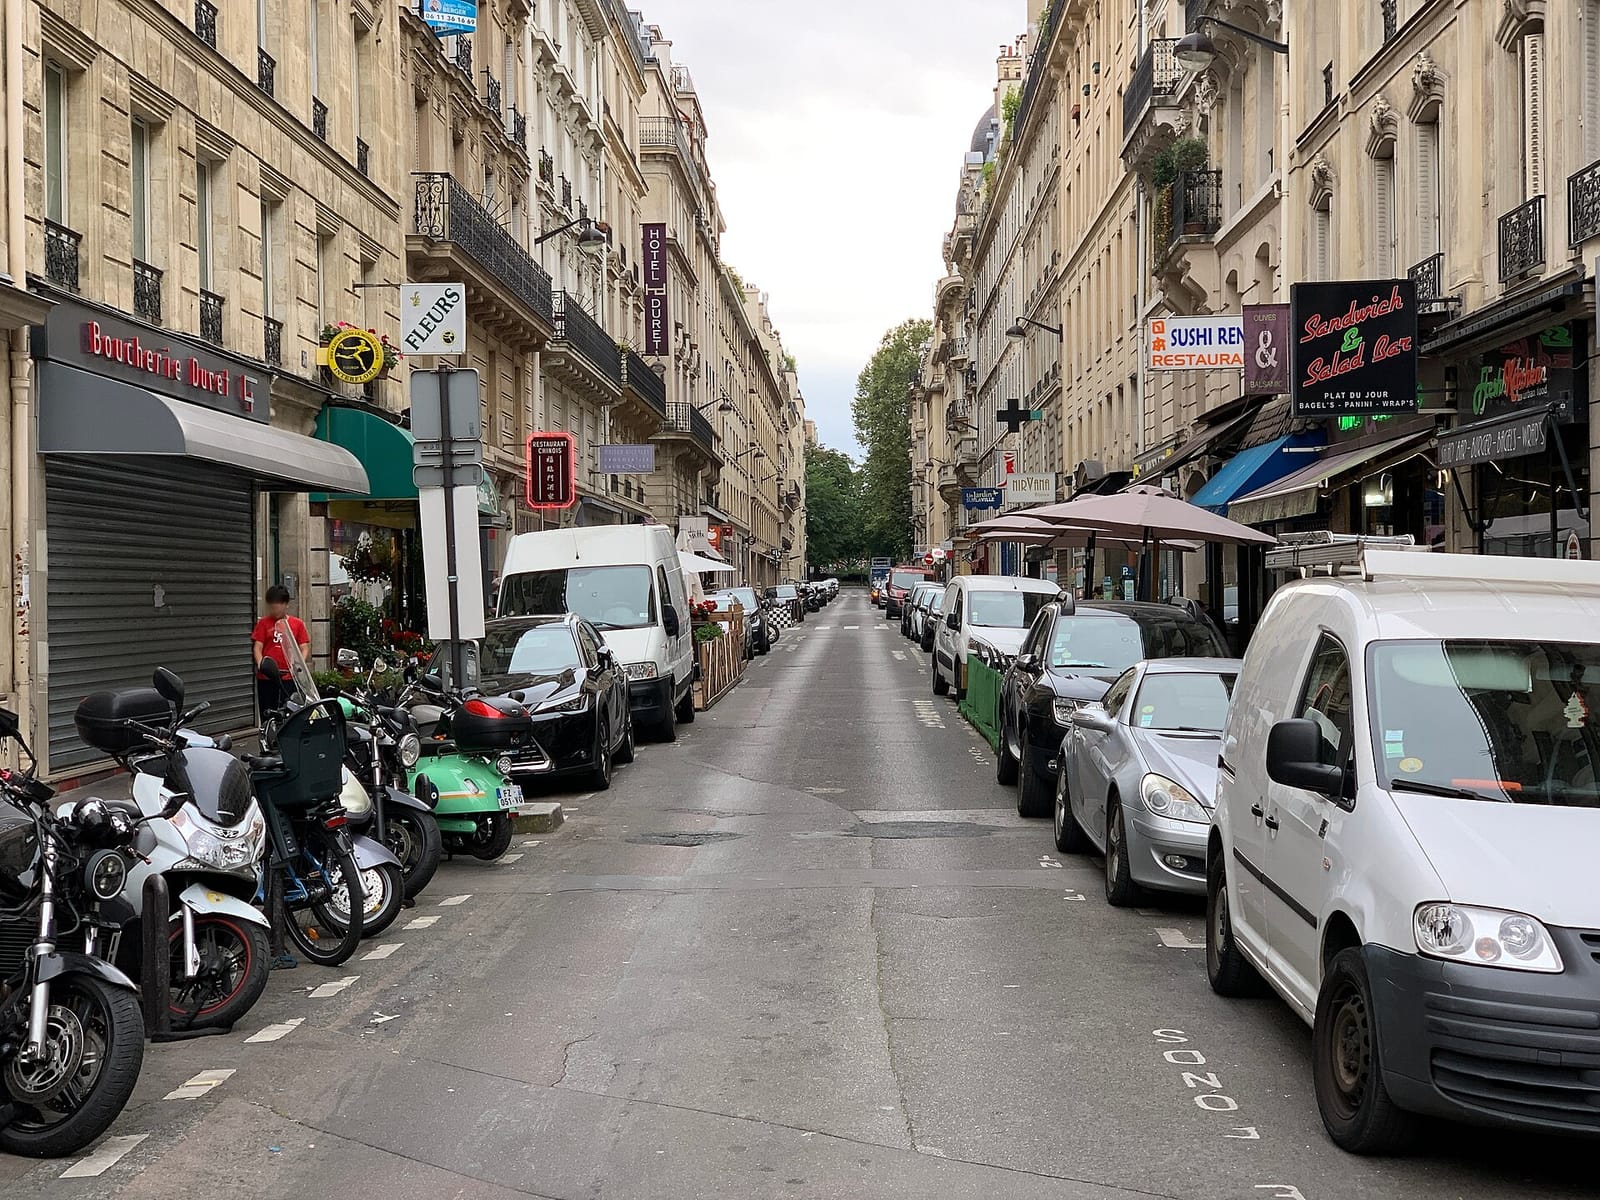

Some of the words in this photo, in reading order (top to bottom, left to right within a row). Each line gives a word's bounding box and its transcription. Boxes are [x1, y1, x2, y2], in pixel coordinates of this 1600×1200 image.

[649, 229, 660, 281] HOTEL
[404, 287, 460, 351] FLEURS
[1253, 313, 1277, 322] OLIVES
[1300, 285, 1403, 343] Sandwich
[651, 298, 662, 350] DURET
[1170, 327, 1212, 346] SUSHI
[1341, 327, 1363, 352] &
[87, 319, 182, 381] Boucherie
[187, 356, 230, 397] Duret
[1151, 353, 1243, 367] RESTAURA
[1302, 341, 1366, 388] Salad
[1372, 335, 1412, 363] Bar
[333, 366, 377, 382] INTERFLORA
[1324, 391, 1346, 400] PLAT
[1349, 391, 1361, 399] DU
[1299, 401, 1335, 409] BAGEL'S
[1344, 400, 1373, 408] PANINI
[532, 440, 568, 448] RESTAURANT
[537, 447, 563, 455] CHINOIS
[1012, 476, 1050, 492] NIRVANA
